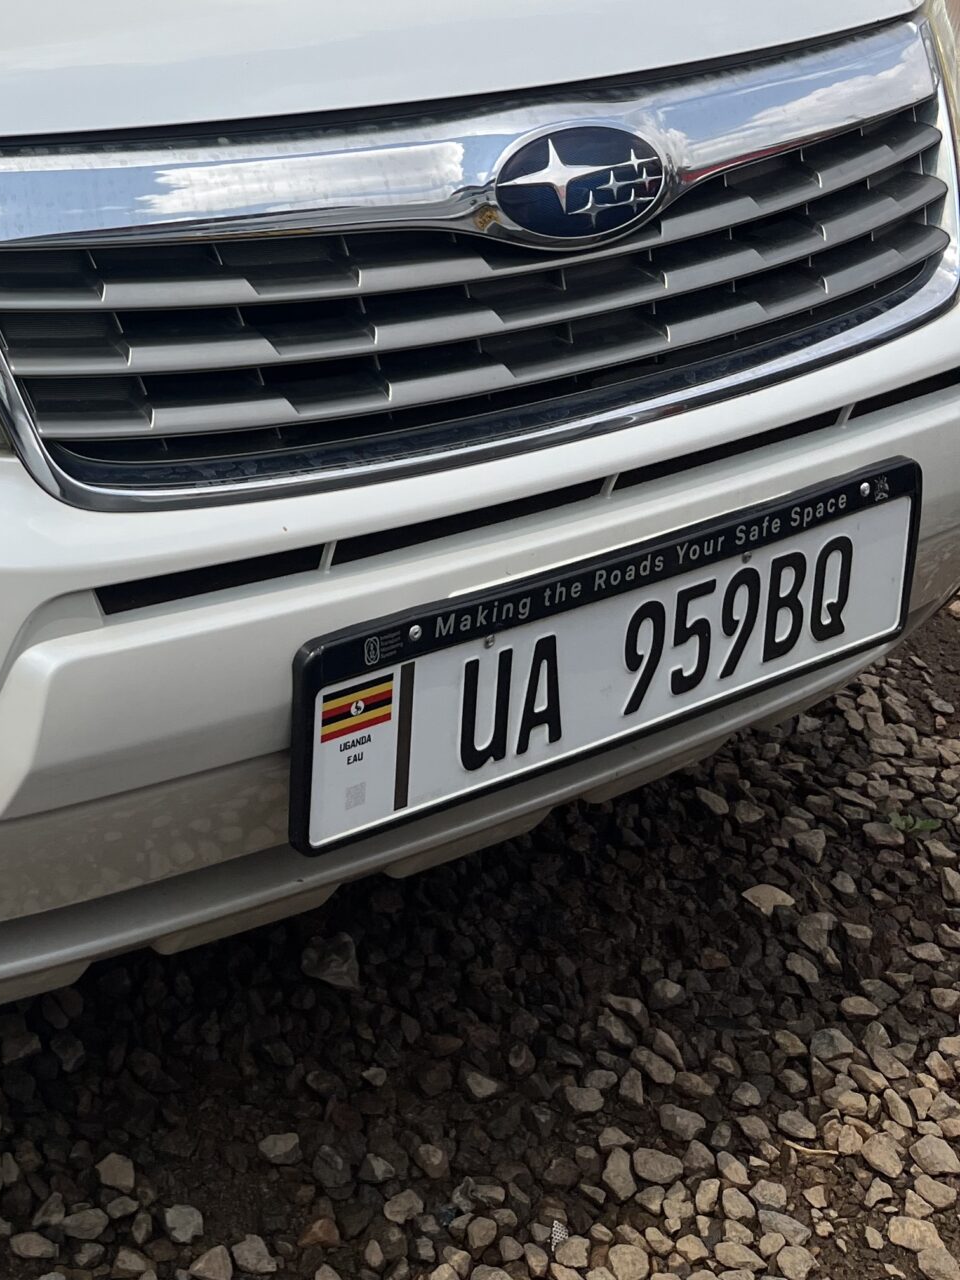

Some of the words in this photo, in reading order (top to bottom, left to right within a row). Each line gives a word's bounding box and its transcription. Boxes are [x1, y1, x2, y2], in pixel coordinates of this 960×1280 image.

[435, 596, 531, 638] Making
[544, 582, 582, 607] the
[594, 554, 665, 591] Roads
[676, 535, 725, 565] Your
[735, 515, 781, 546] Safe
[790, 493, 847, 528] Space
[459, 634, 562, 772] UA
[623, 535, 854, 717] 959BQ
[339, 734, 372, 753] UGANDA
[346, 752, 364, 766] EAU
